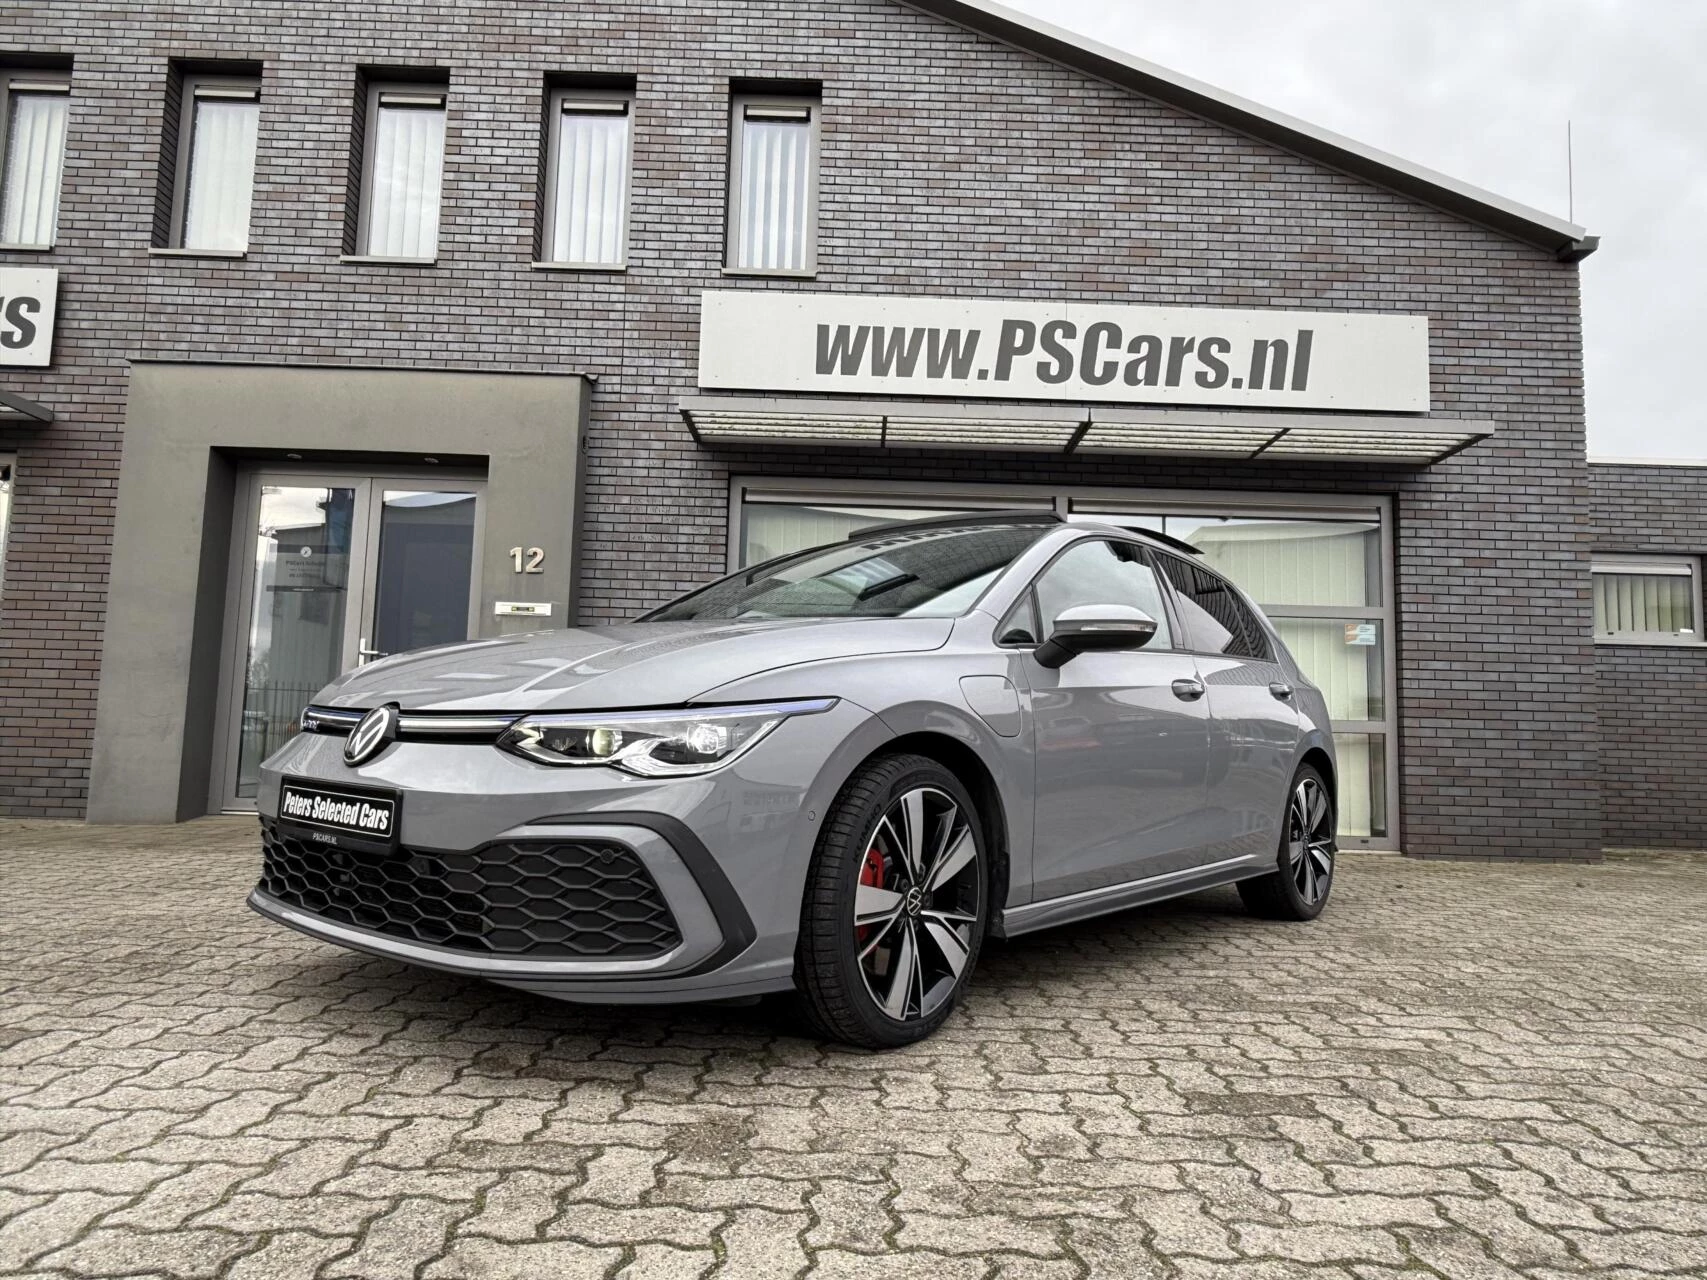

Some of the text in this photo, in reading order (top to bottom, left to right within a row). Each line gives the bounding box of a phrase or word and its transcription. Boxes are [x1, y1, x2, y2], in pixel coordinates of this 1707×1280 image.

[815, 318, 1314, 392] www.PSCars.nl
[510, 546, 545, 574] 12
[283, 791, 389, 831] Peters Selected Cars
